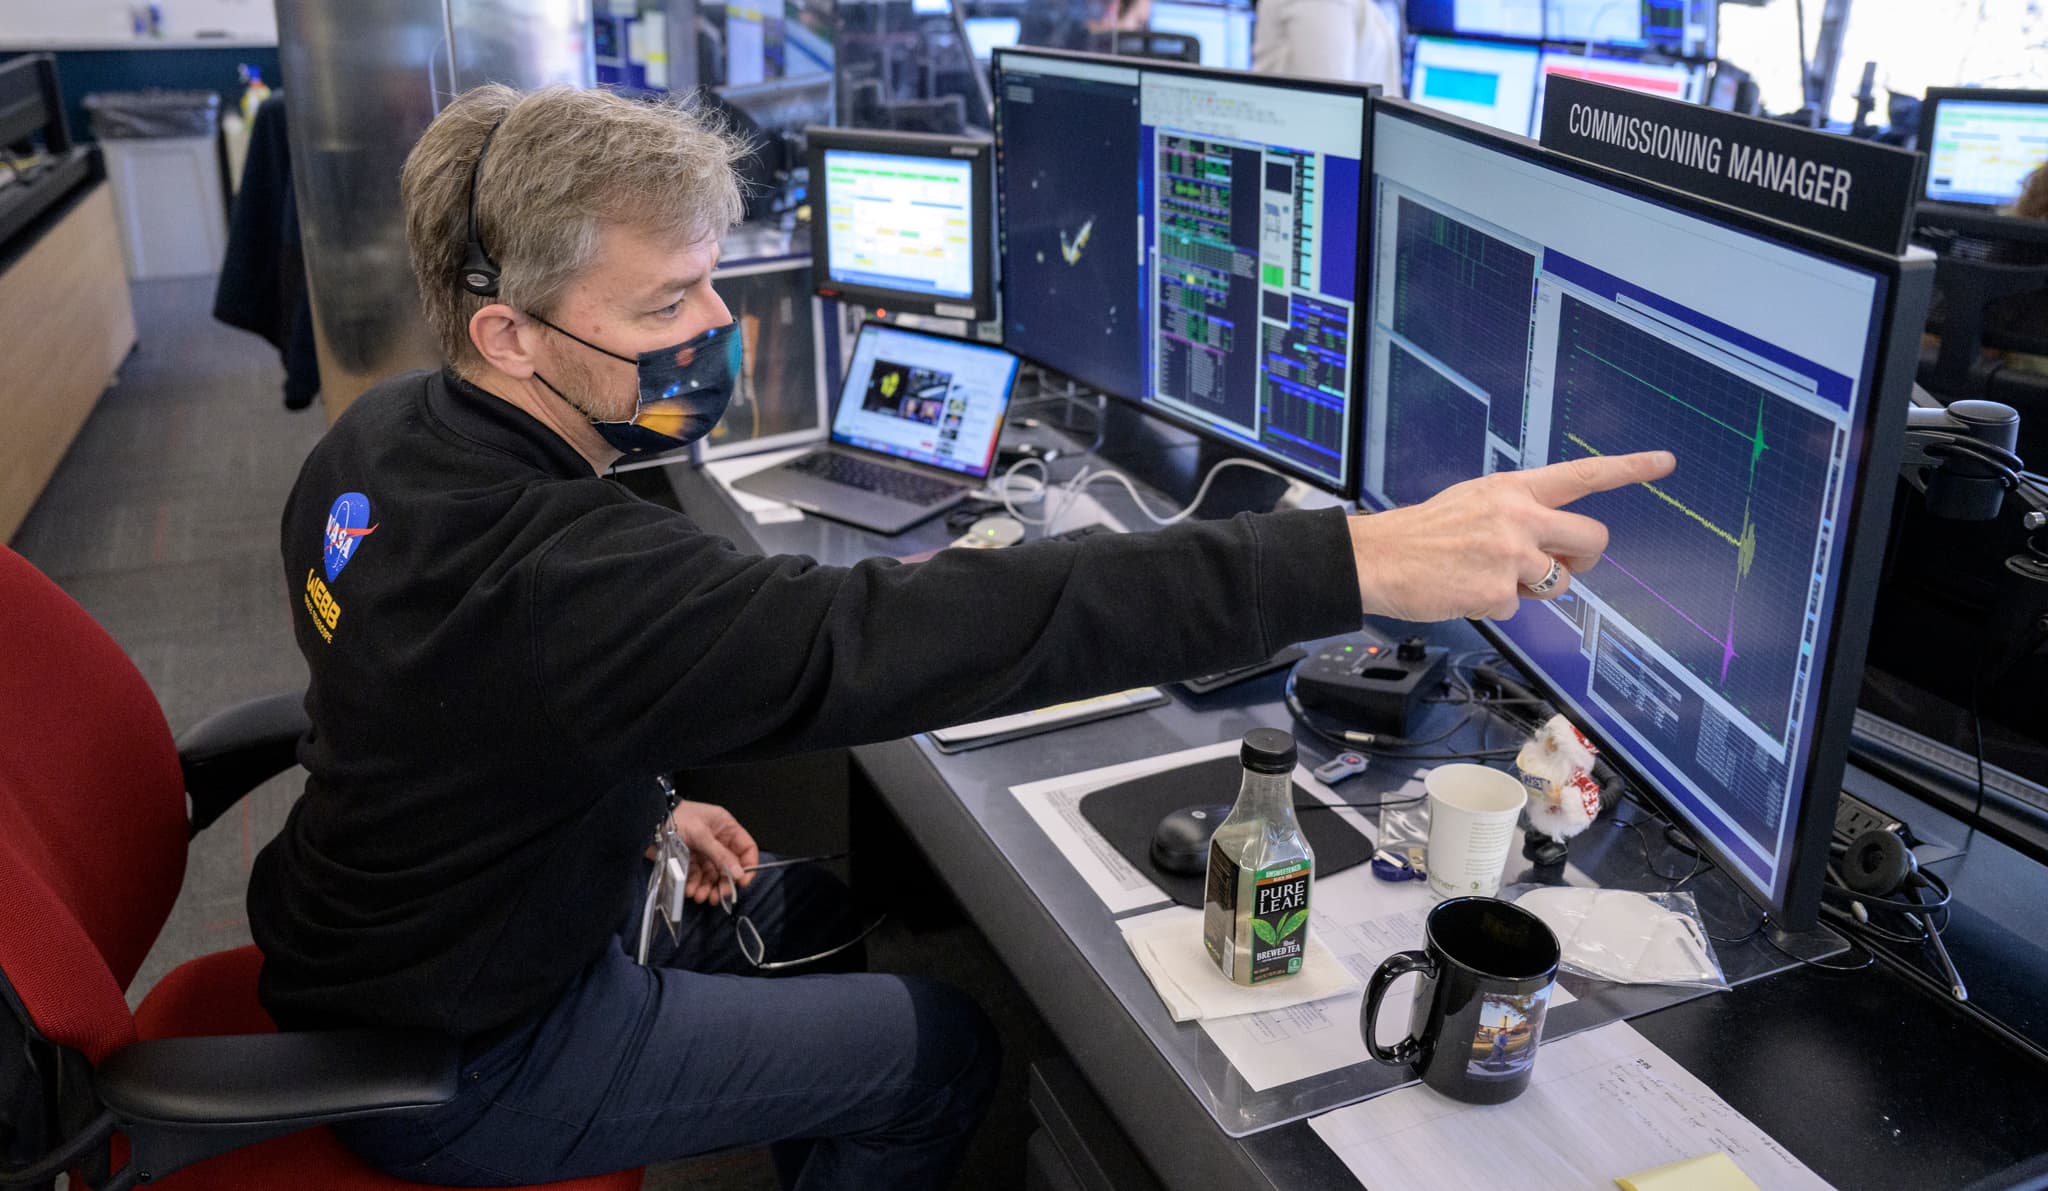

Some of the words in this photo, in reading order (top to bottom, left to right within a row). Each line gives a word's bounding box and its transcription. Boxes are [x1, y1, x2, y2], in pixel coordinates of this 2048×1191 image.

[1569, 103, 1722, 174] COMMISSIONING
[1727, 143, 1852, 212] MANAGER
[326, 513, 353, 559] NASA
[306, 567, 341, 630] WEBB
[1260, 880, 1305, 902] PURE
[1256, 947, 1287, 961] BREWED
[1287, 944, 1301, 953] TEA
